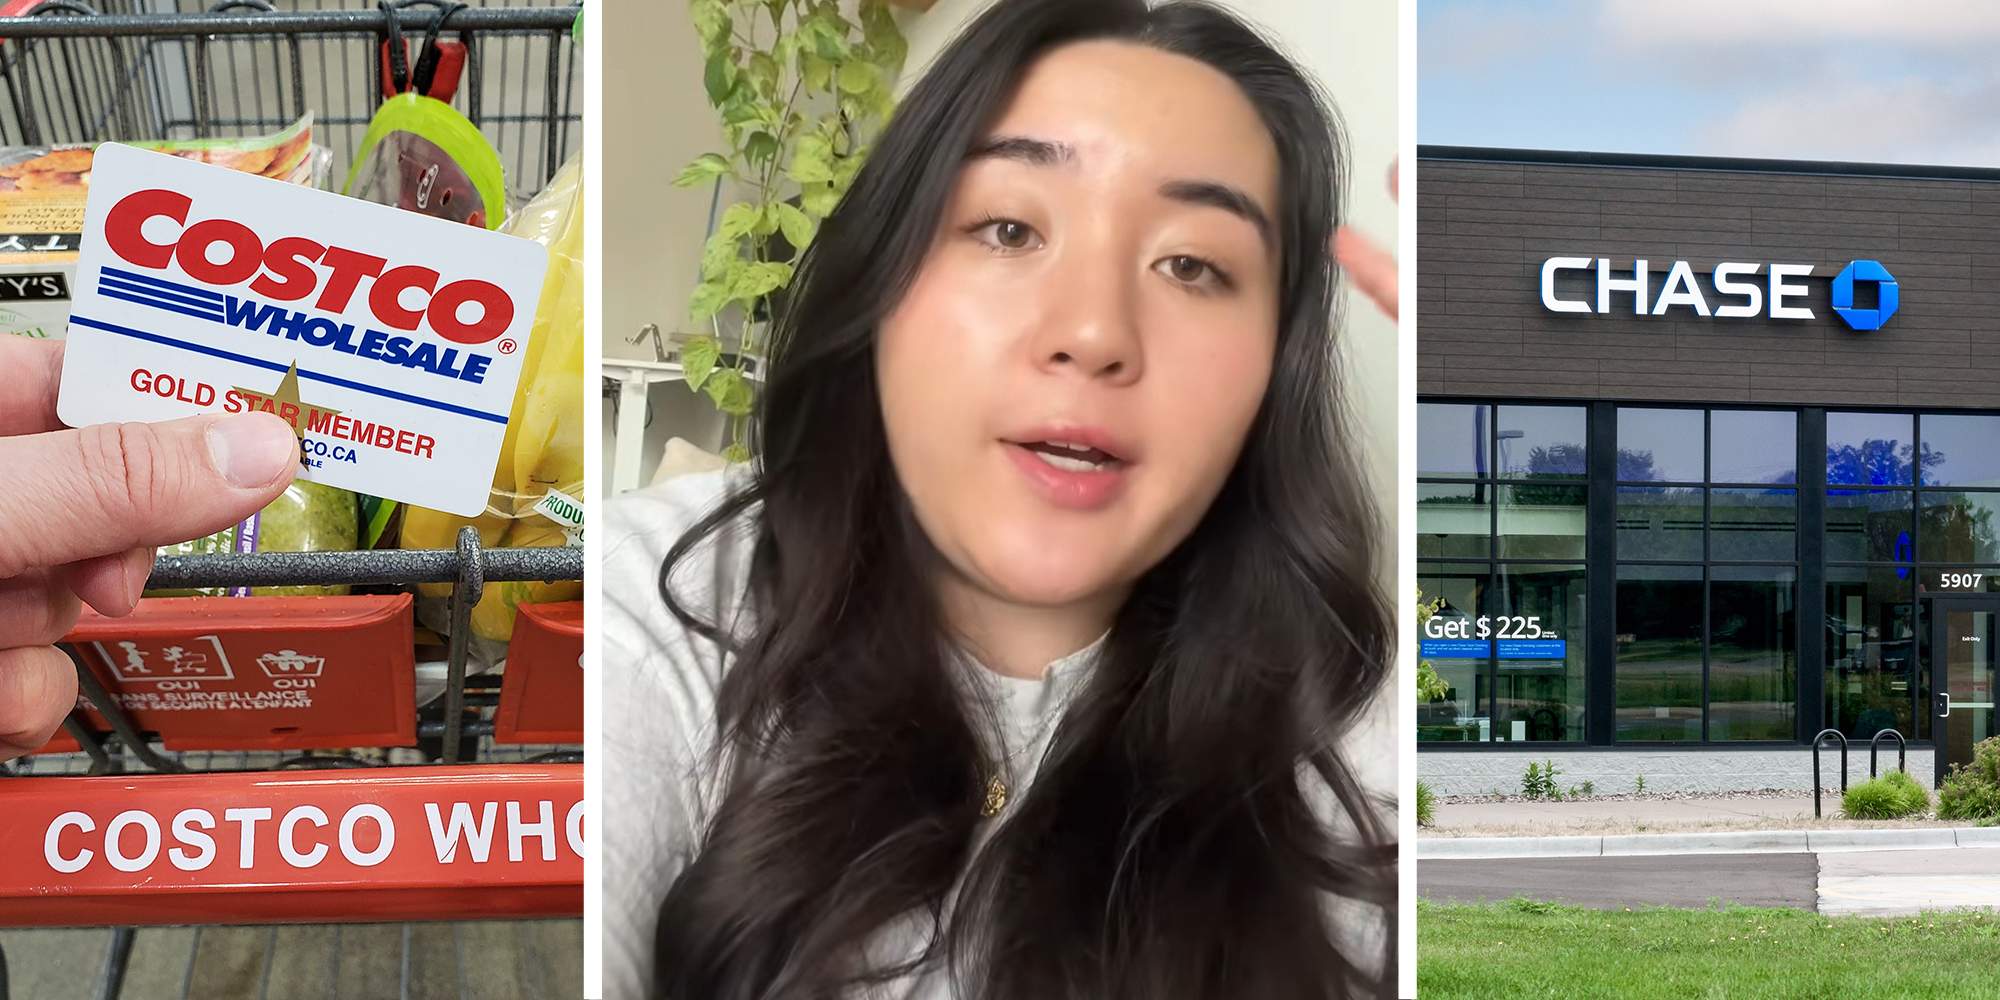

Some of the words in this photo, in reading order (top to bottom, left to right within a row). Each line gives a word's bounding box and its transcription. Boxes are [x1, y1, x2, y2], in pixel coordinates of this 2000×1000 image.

[104, 188, 515, 345] COSTCO
[1539, 256, 1816, 320] CHASE
[225, 295, 492, 385] WHOLESALE
[130, 368, 216, 407] GOLD
[223, 390, 300, 429] STAR
[307, 408, 436, 459] MEMBER
[541, 495, 584, 525] PRODU
[1940, 573, 1983, 588] 5907
[1424, 615, 1470, 639] Get
[1496, 616, 1541, 639] 225
[157, 681, 200, 690] OUI
[164, 690, 309, 701] SURVEILLANCE
[273, 679, 316, 688] OUI
[43, 803, 396, 873] COSTCO
